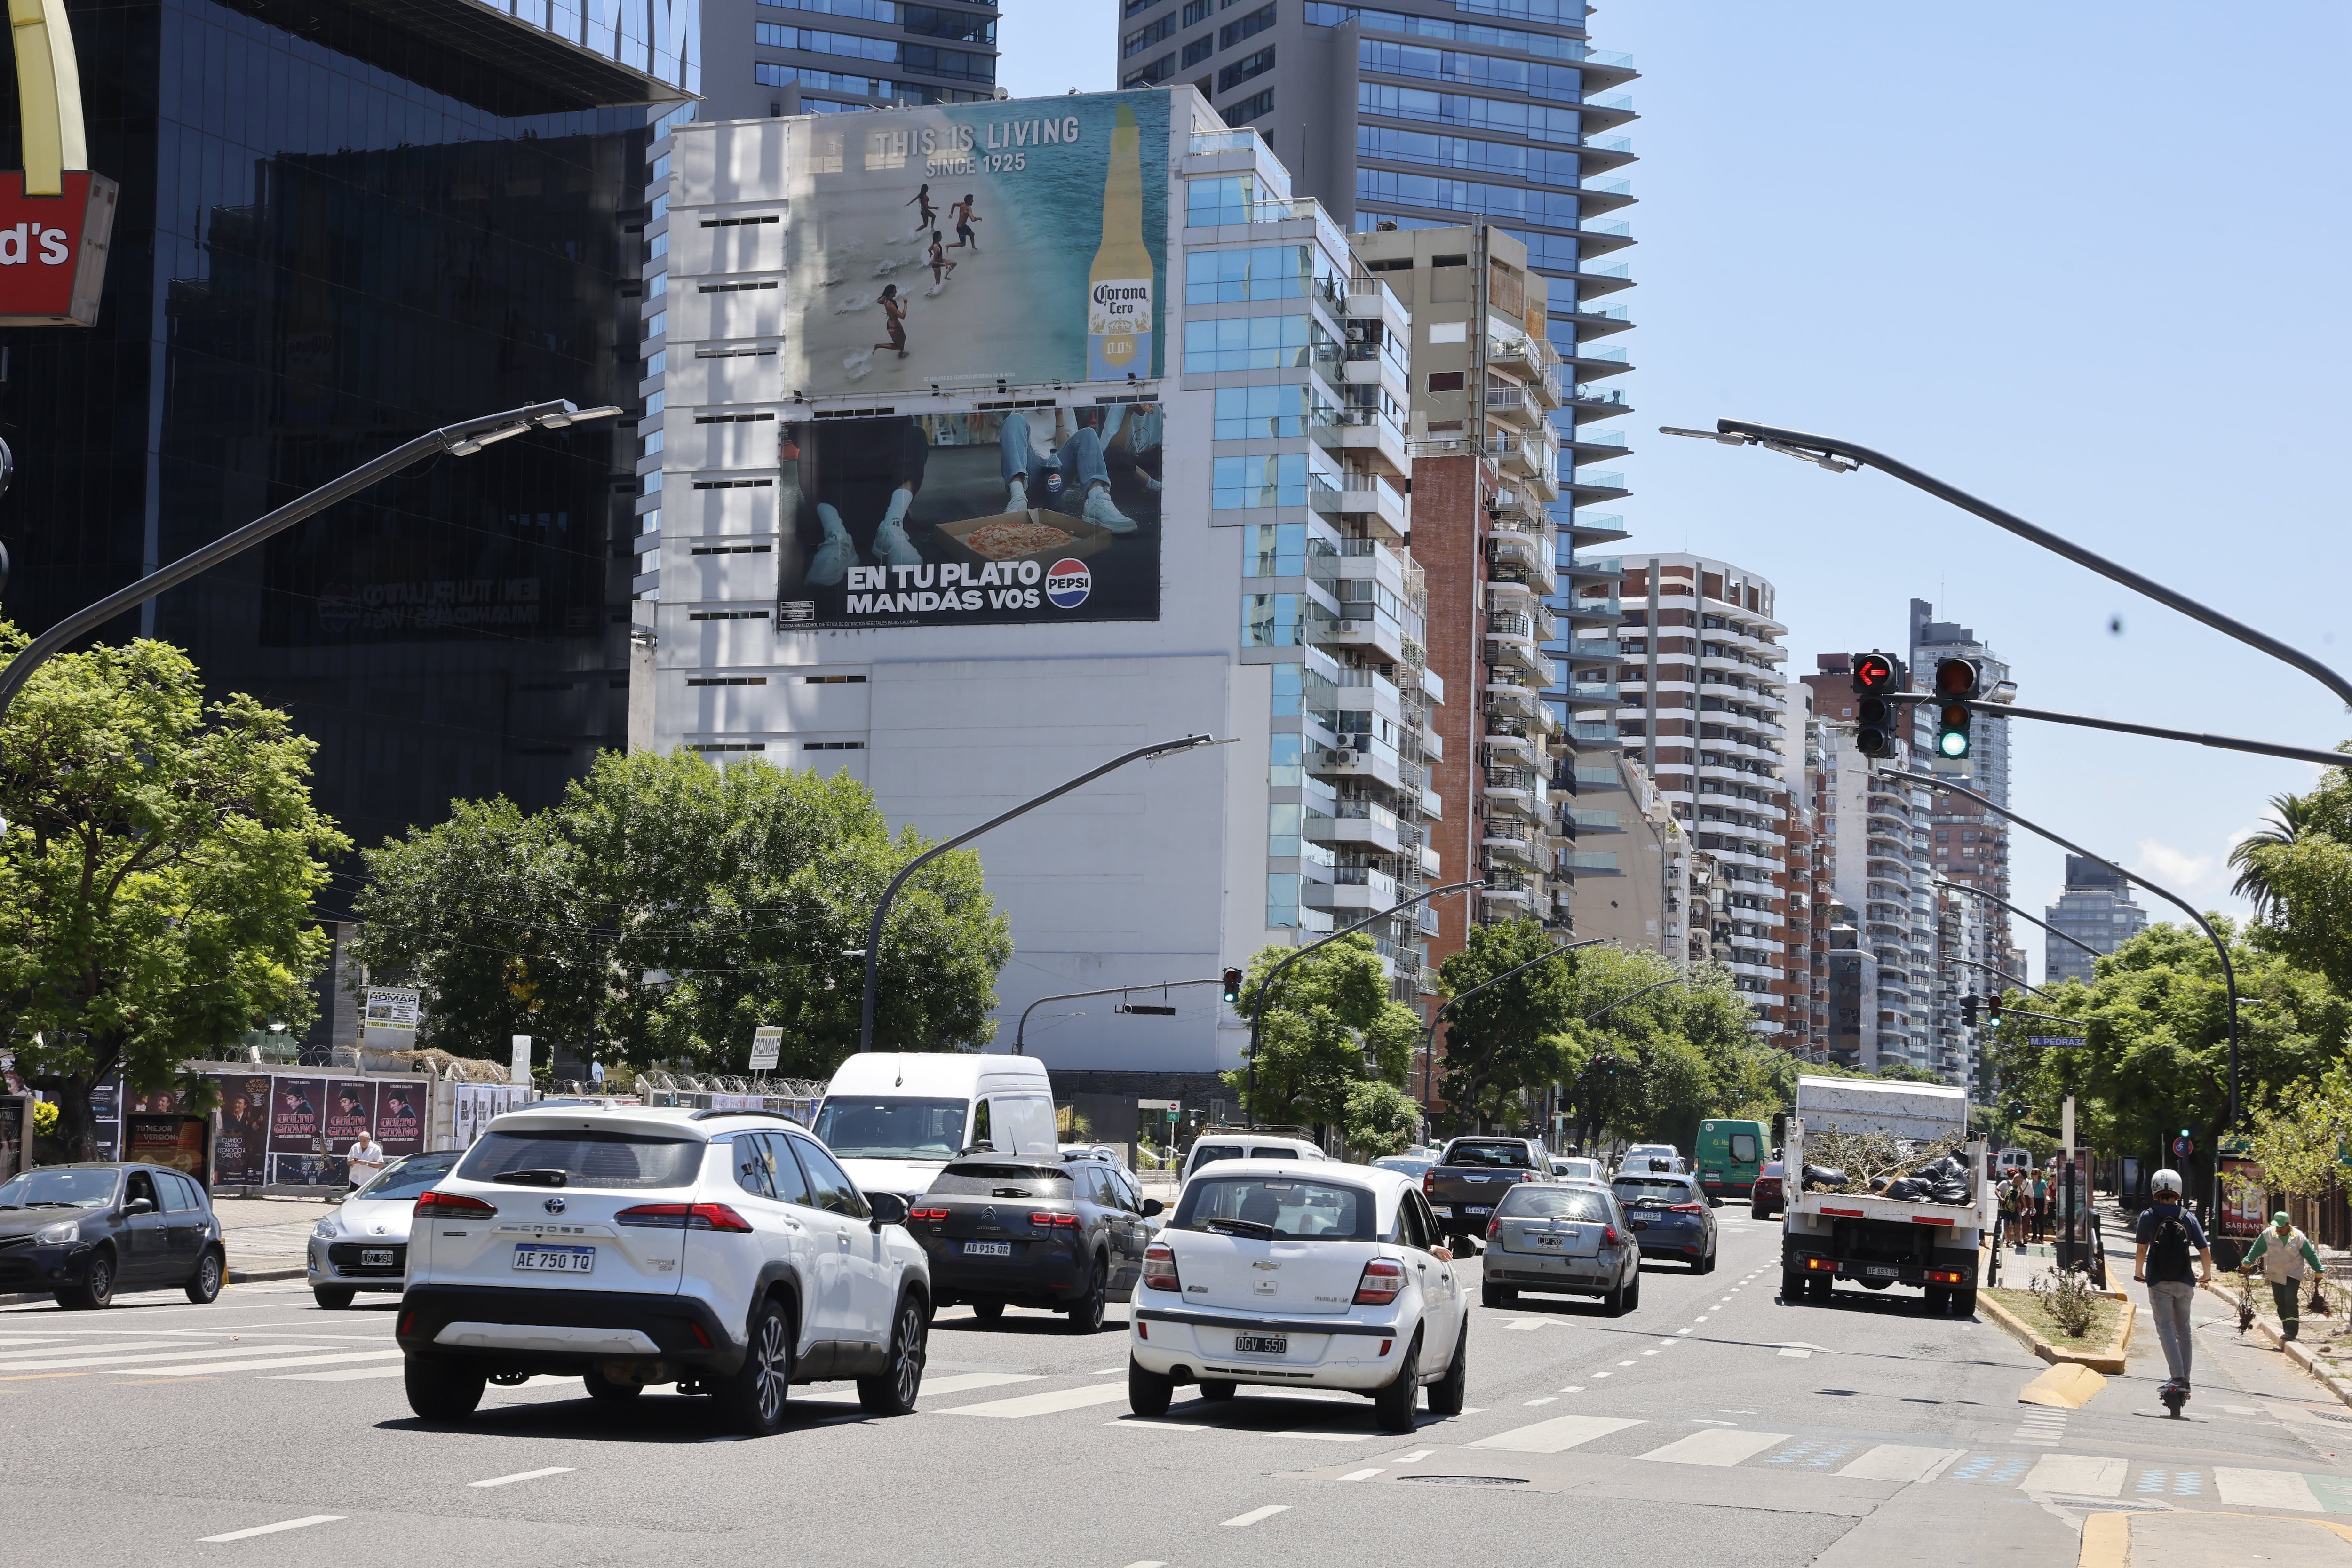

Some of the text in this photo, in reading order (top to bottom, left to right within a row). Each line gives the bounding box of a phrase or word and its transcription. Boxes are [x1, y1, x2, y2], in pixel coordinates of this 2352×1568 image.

[875, 116, 1079, 158] THIS IS LIVING
[925, 152, 1025, 177] SINCE 1925
[0, 223, 69, 265] d's
[1093, 284, 1147, 306] Corona
[1109, 302, 1133, 315] Cero
[847, 559, 1041, 590] EN TU PLATO
[1049, 577, 1089, 589] PEPSI
[847, 586, 1040, 614] MANDÁS VOS
[370, 994, 417, 1003] ROMAR
[754, 1038, 781, 1054] ROMAR
[277, 1114, 314, 1123] CULTO
[331, 1116, 365, 1126] CULTO
[380, 1118, 416, 1127] CULTO
[274, 1124, 316, 1133] GITANO
[377, 1127, 418, 1137] GITANO
[302, 1162, 325, 1171] 27 28
[966, 1243, 1008, 1255] AD 915 QR
[517, 1252, 589, 1269] AE 750 TQ
[1237, 1337, 1285, 1352] OGV 550
